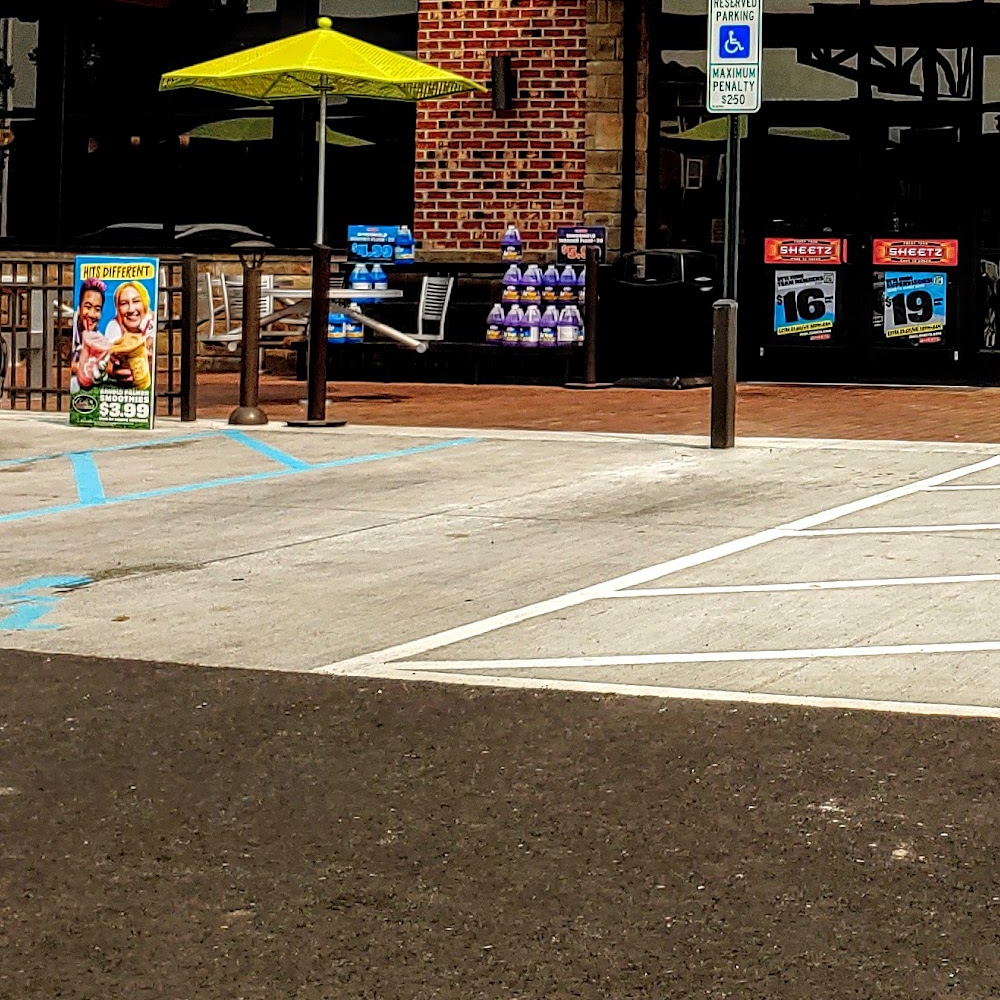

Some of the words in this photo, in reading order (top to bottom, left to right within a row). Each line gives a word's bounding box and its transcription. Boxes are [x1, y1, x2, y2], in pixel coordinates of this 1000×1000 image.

[715, 10, 756, 22] PARKING
[712, 67, 756, 79] MAXIMUM
[712, 80, 756, 92] PENALTY
[721, 94, 746, 105] $250
[780, 245, 833, 255] SHEETZ
[889, 247, 943, 257] SHEETZ
[83, 265, 101, 279] HITS
[103, 265, 151, 279] DIFFERENT
[99, 395, 150, 404] SMOOTHIES
[99, 401, 150, 419] $3.99
